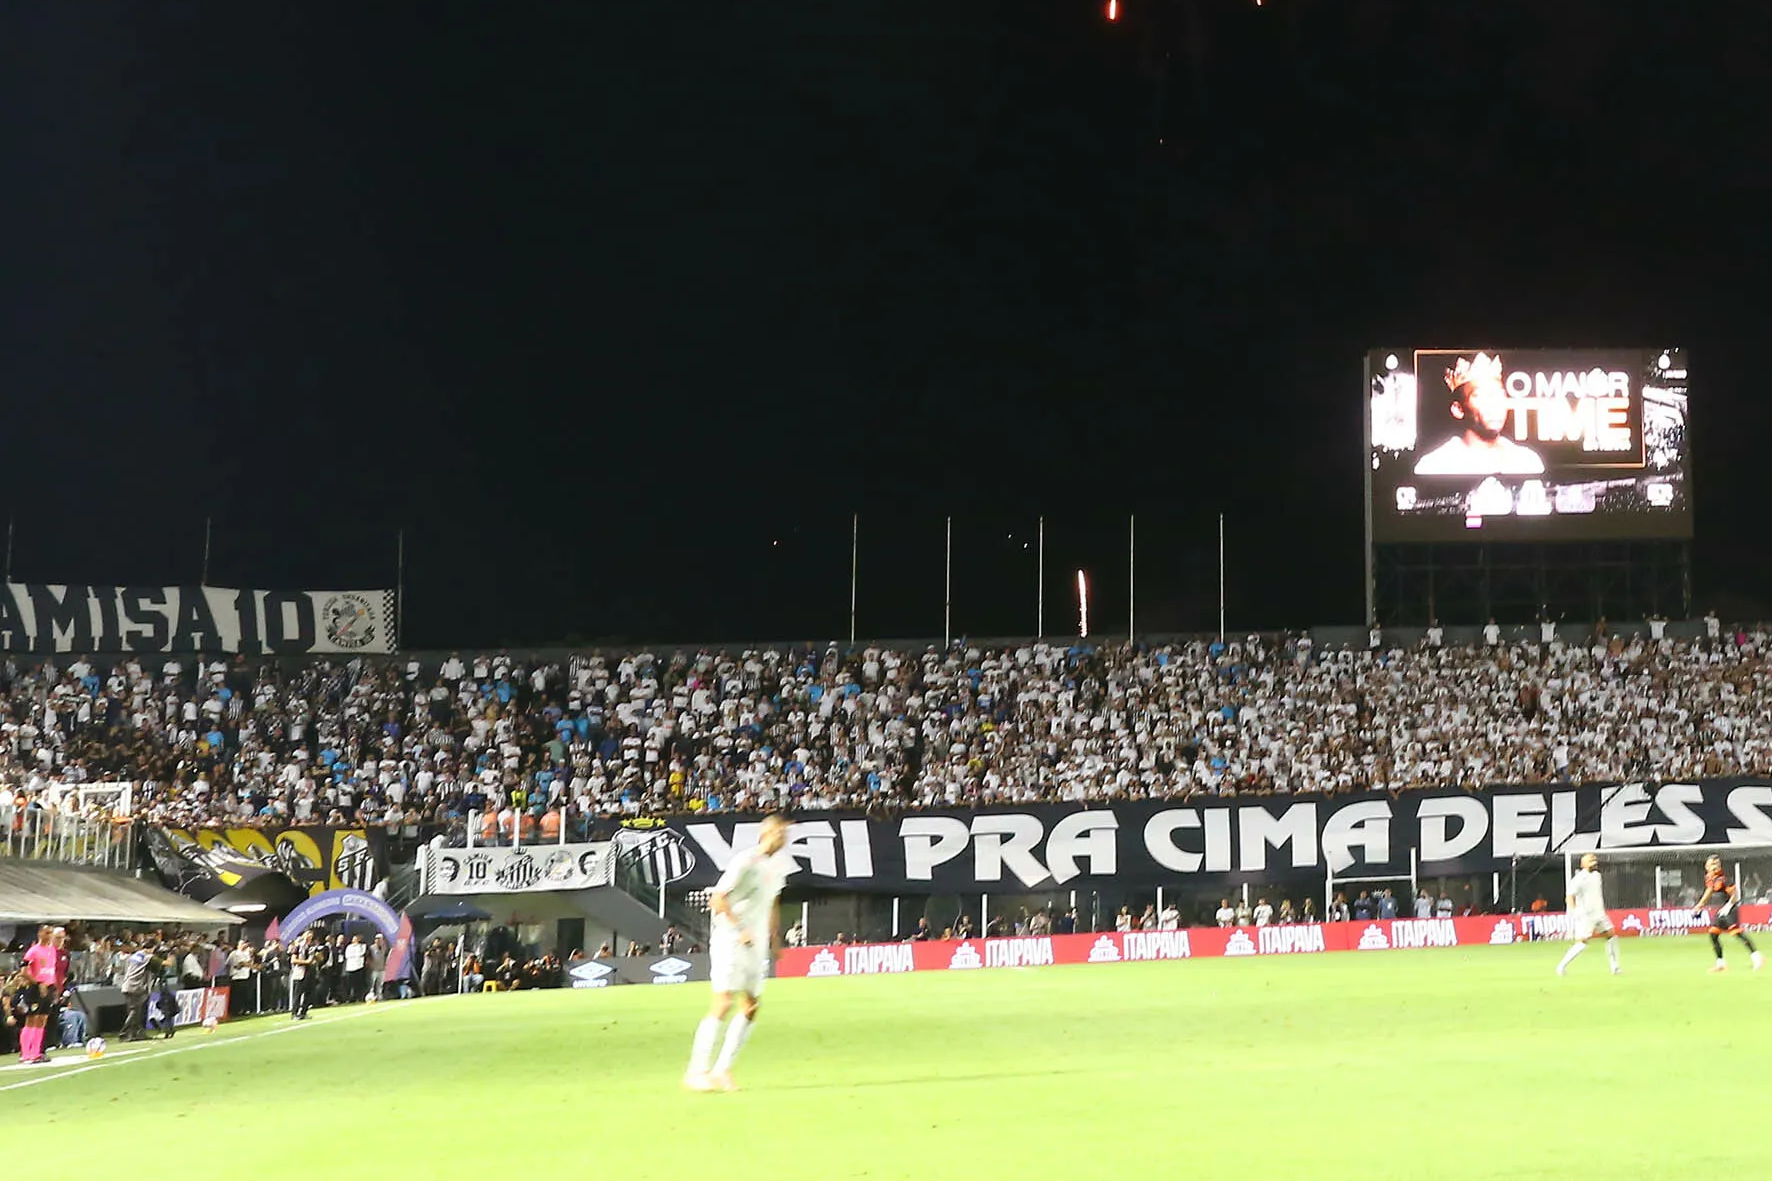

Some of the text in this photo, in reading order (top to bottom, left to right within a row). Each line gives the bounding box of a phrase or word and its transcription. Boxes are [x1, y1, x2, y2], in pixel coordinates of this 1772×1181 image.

[1505, 371, 1532, 398] O
[1502, 396, 1632, 441] TIME
[235, 588, 317, 654] 10
[899, 812, 1120, 888] PRA
[1144, 799, 1394, 875] CIMA
[1416, 784, 1705, 862] DELES
[469, 861, 487, 880] 10
[1122, 931, 1191, 961] ITAIPAVA
[1259, 924, 1326, 954] ITAIPAVA
[1391, 919, 1458, 949] ITAIPAVA
[844, 943, 914, 975] ITAIPAVA
[985, 937, 1054, 968] ITAIPAVA
